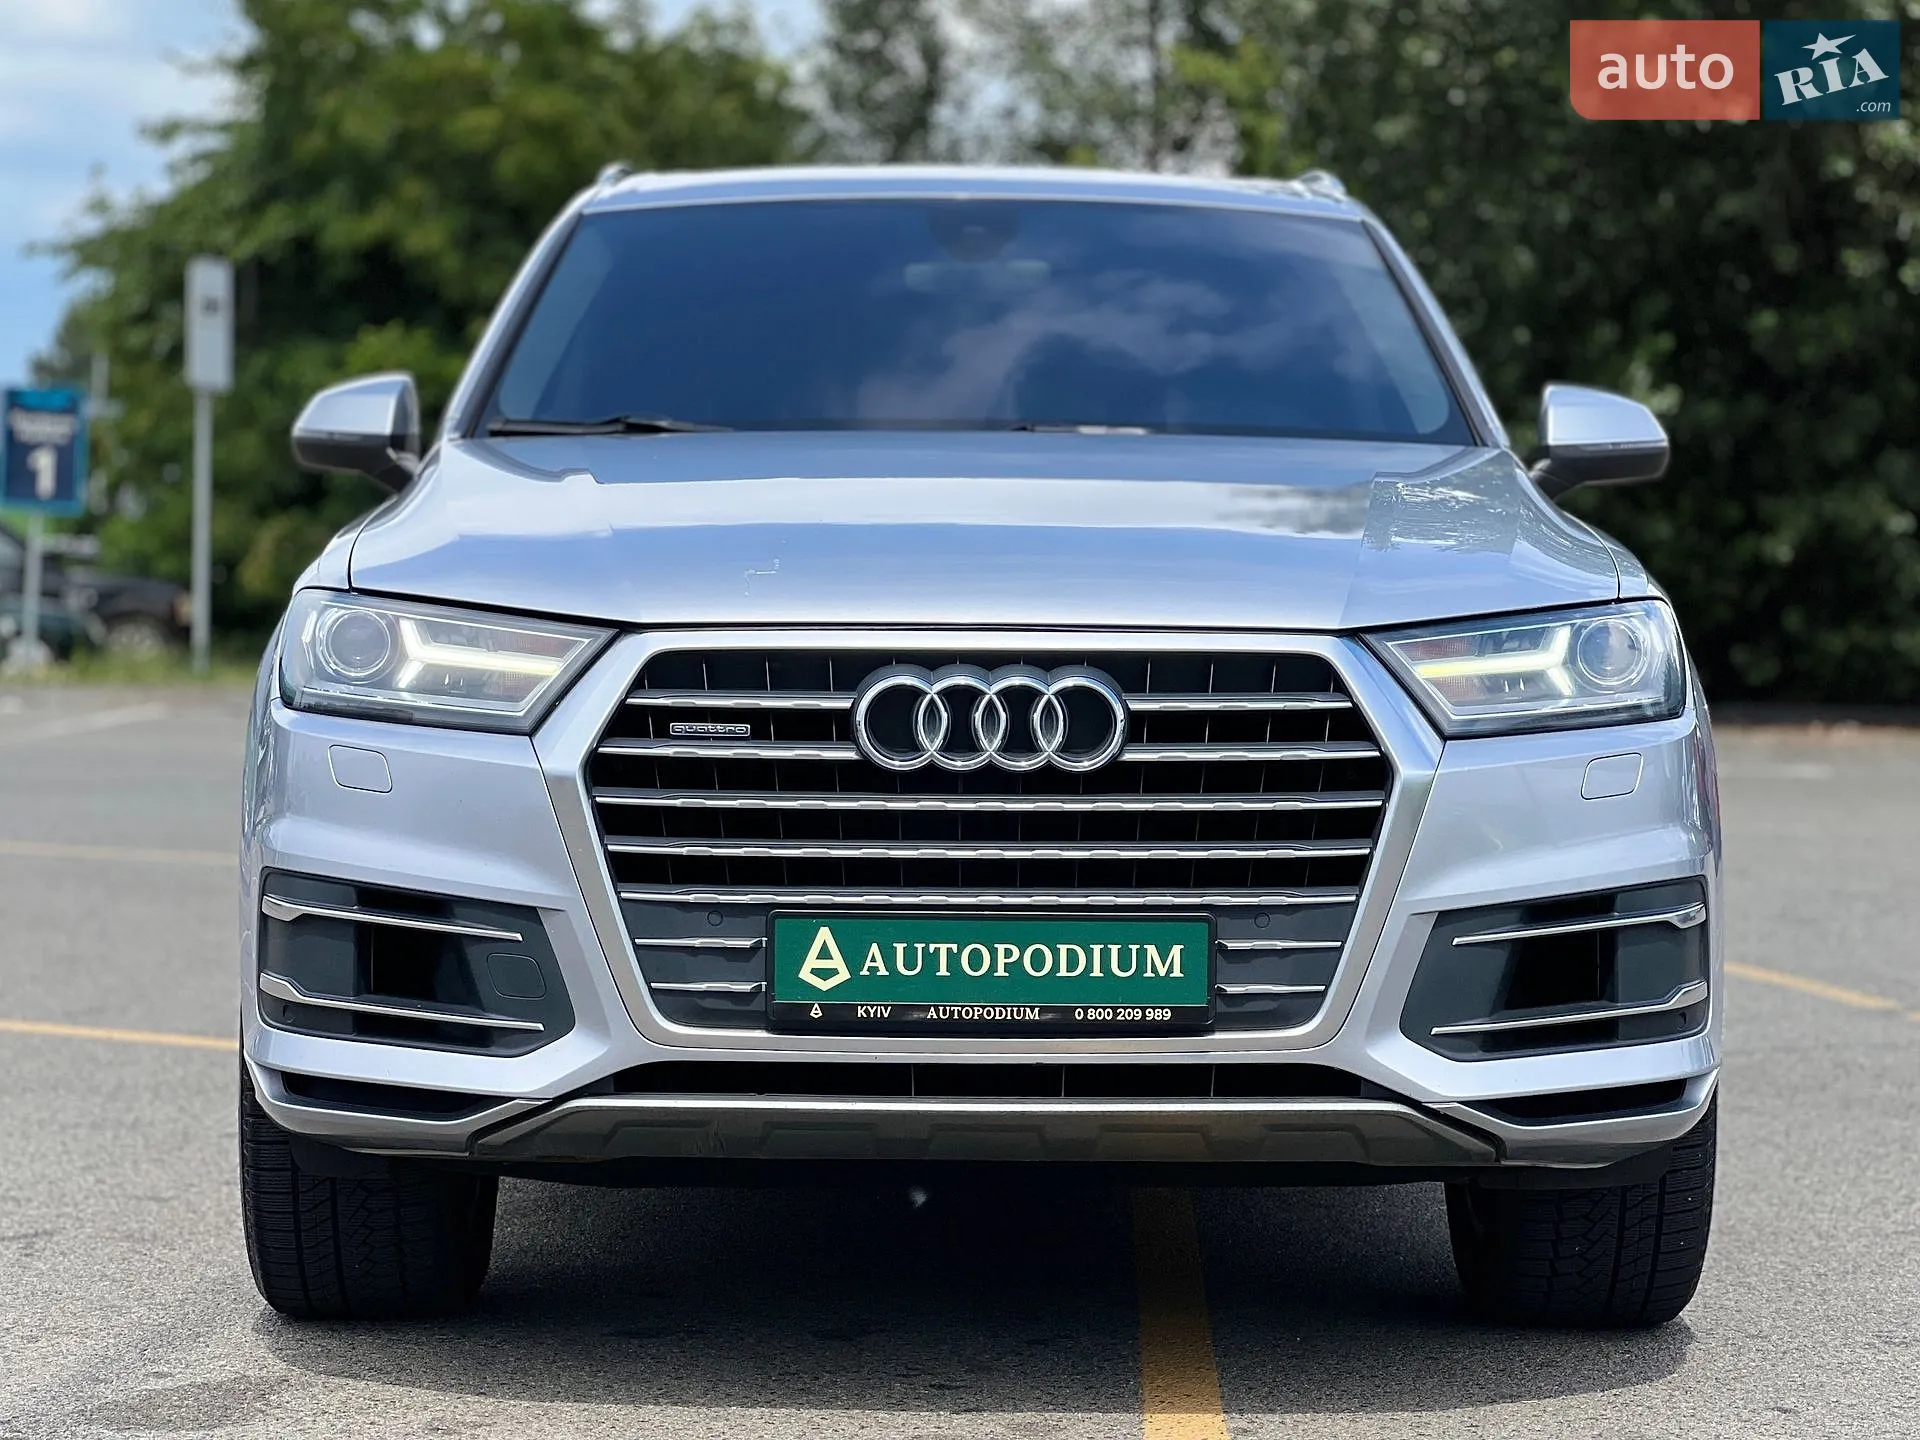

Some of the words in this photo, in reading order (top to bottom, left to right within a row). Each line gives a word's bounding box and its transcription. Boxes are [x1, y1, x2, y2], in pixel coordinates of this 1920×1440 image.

[27, 446, 57, 500] 1
[672, 724, 747, 734] quattro
[859, 942, 1185, 978] AUTOPODIUM
[857, 1005, 892, 1018] KYIV
[926, 1006, 1040, 1020] AUTOPODIUM
[1074, 1008, 1084, 1020] 0
[1087, 1008, 1113, 1020] 800
[1116, 1008, 1142, 1020] 209
[1145, 1008, 1172, 1020] 989
